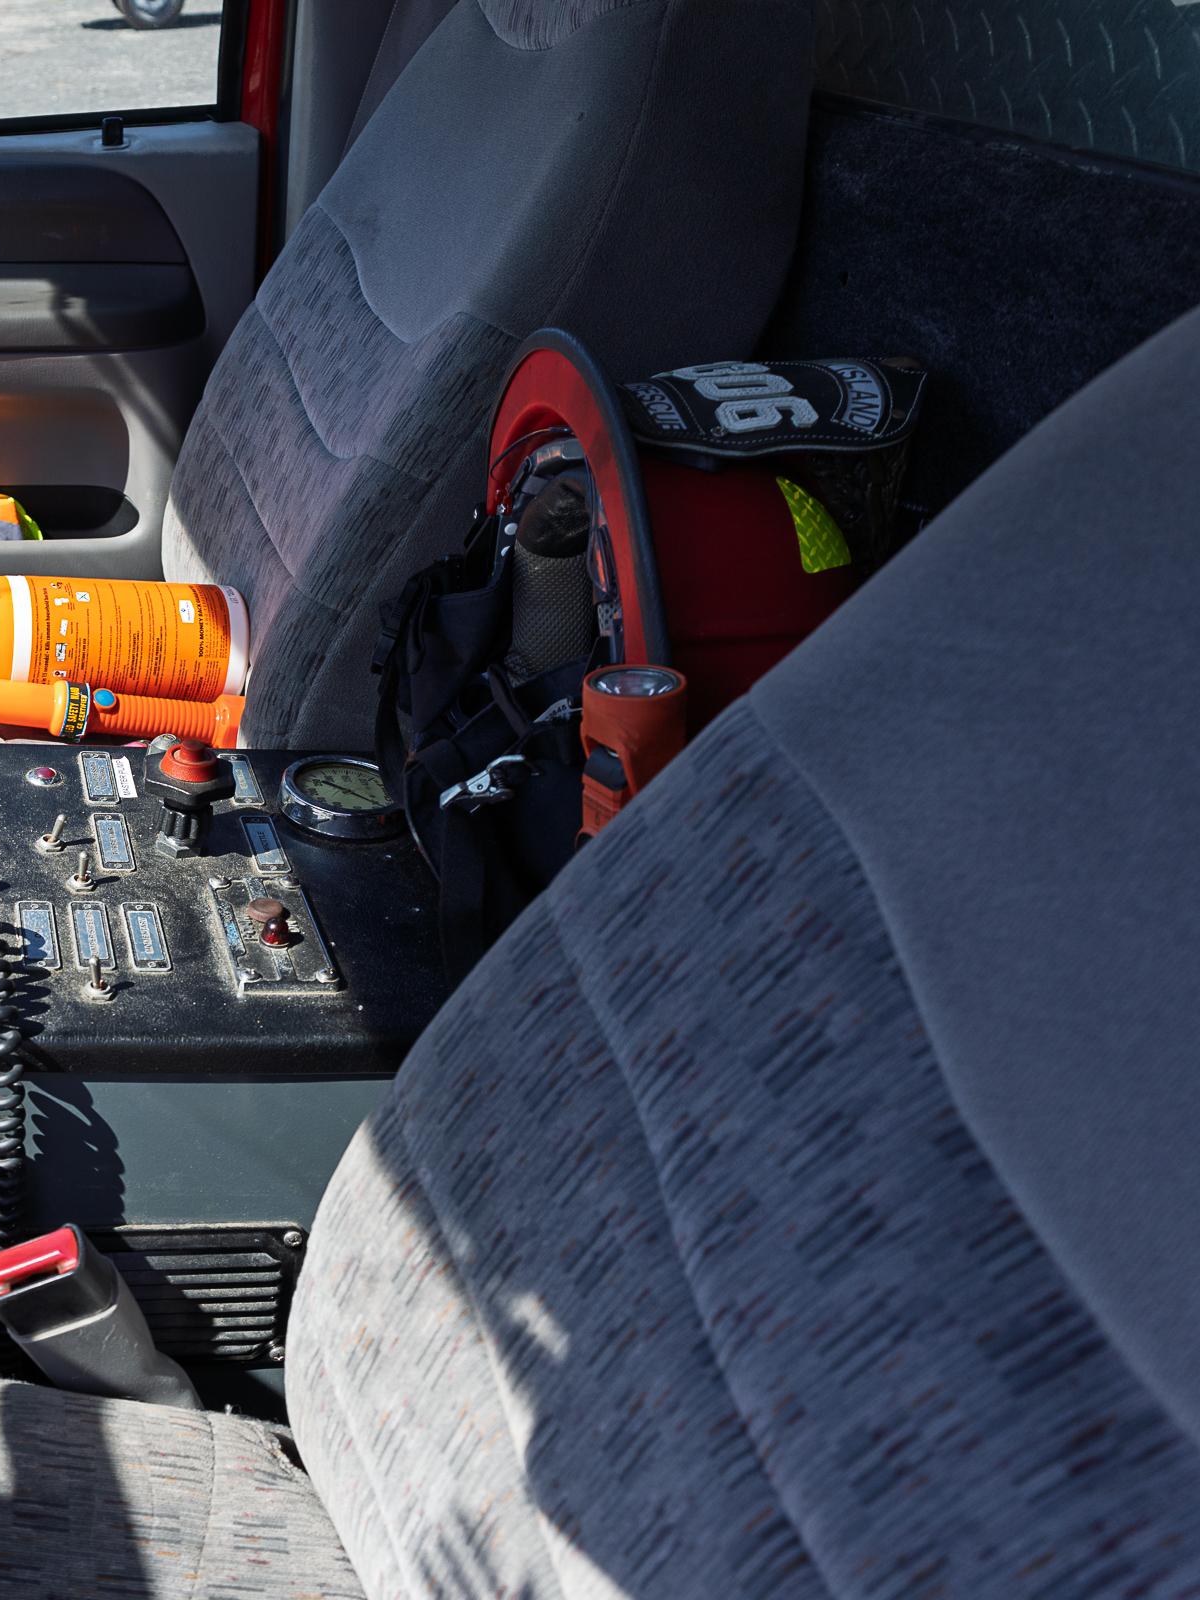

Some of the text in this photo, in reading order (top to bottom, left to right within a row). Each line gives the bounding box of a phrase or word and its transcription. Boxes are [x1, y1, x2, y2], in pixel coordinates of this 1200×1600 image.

[631, 384, 688, 431] RESCUE
[832, 365, 884, 430] ISLAND
[67, 703, 79, 723] SAFETY
[78, 694, 89, 722] CERTIFIED
[119, 773, 131, 796] MASTER
